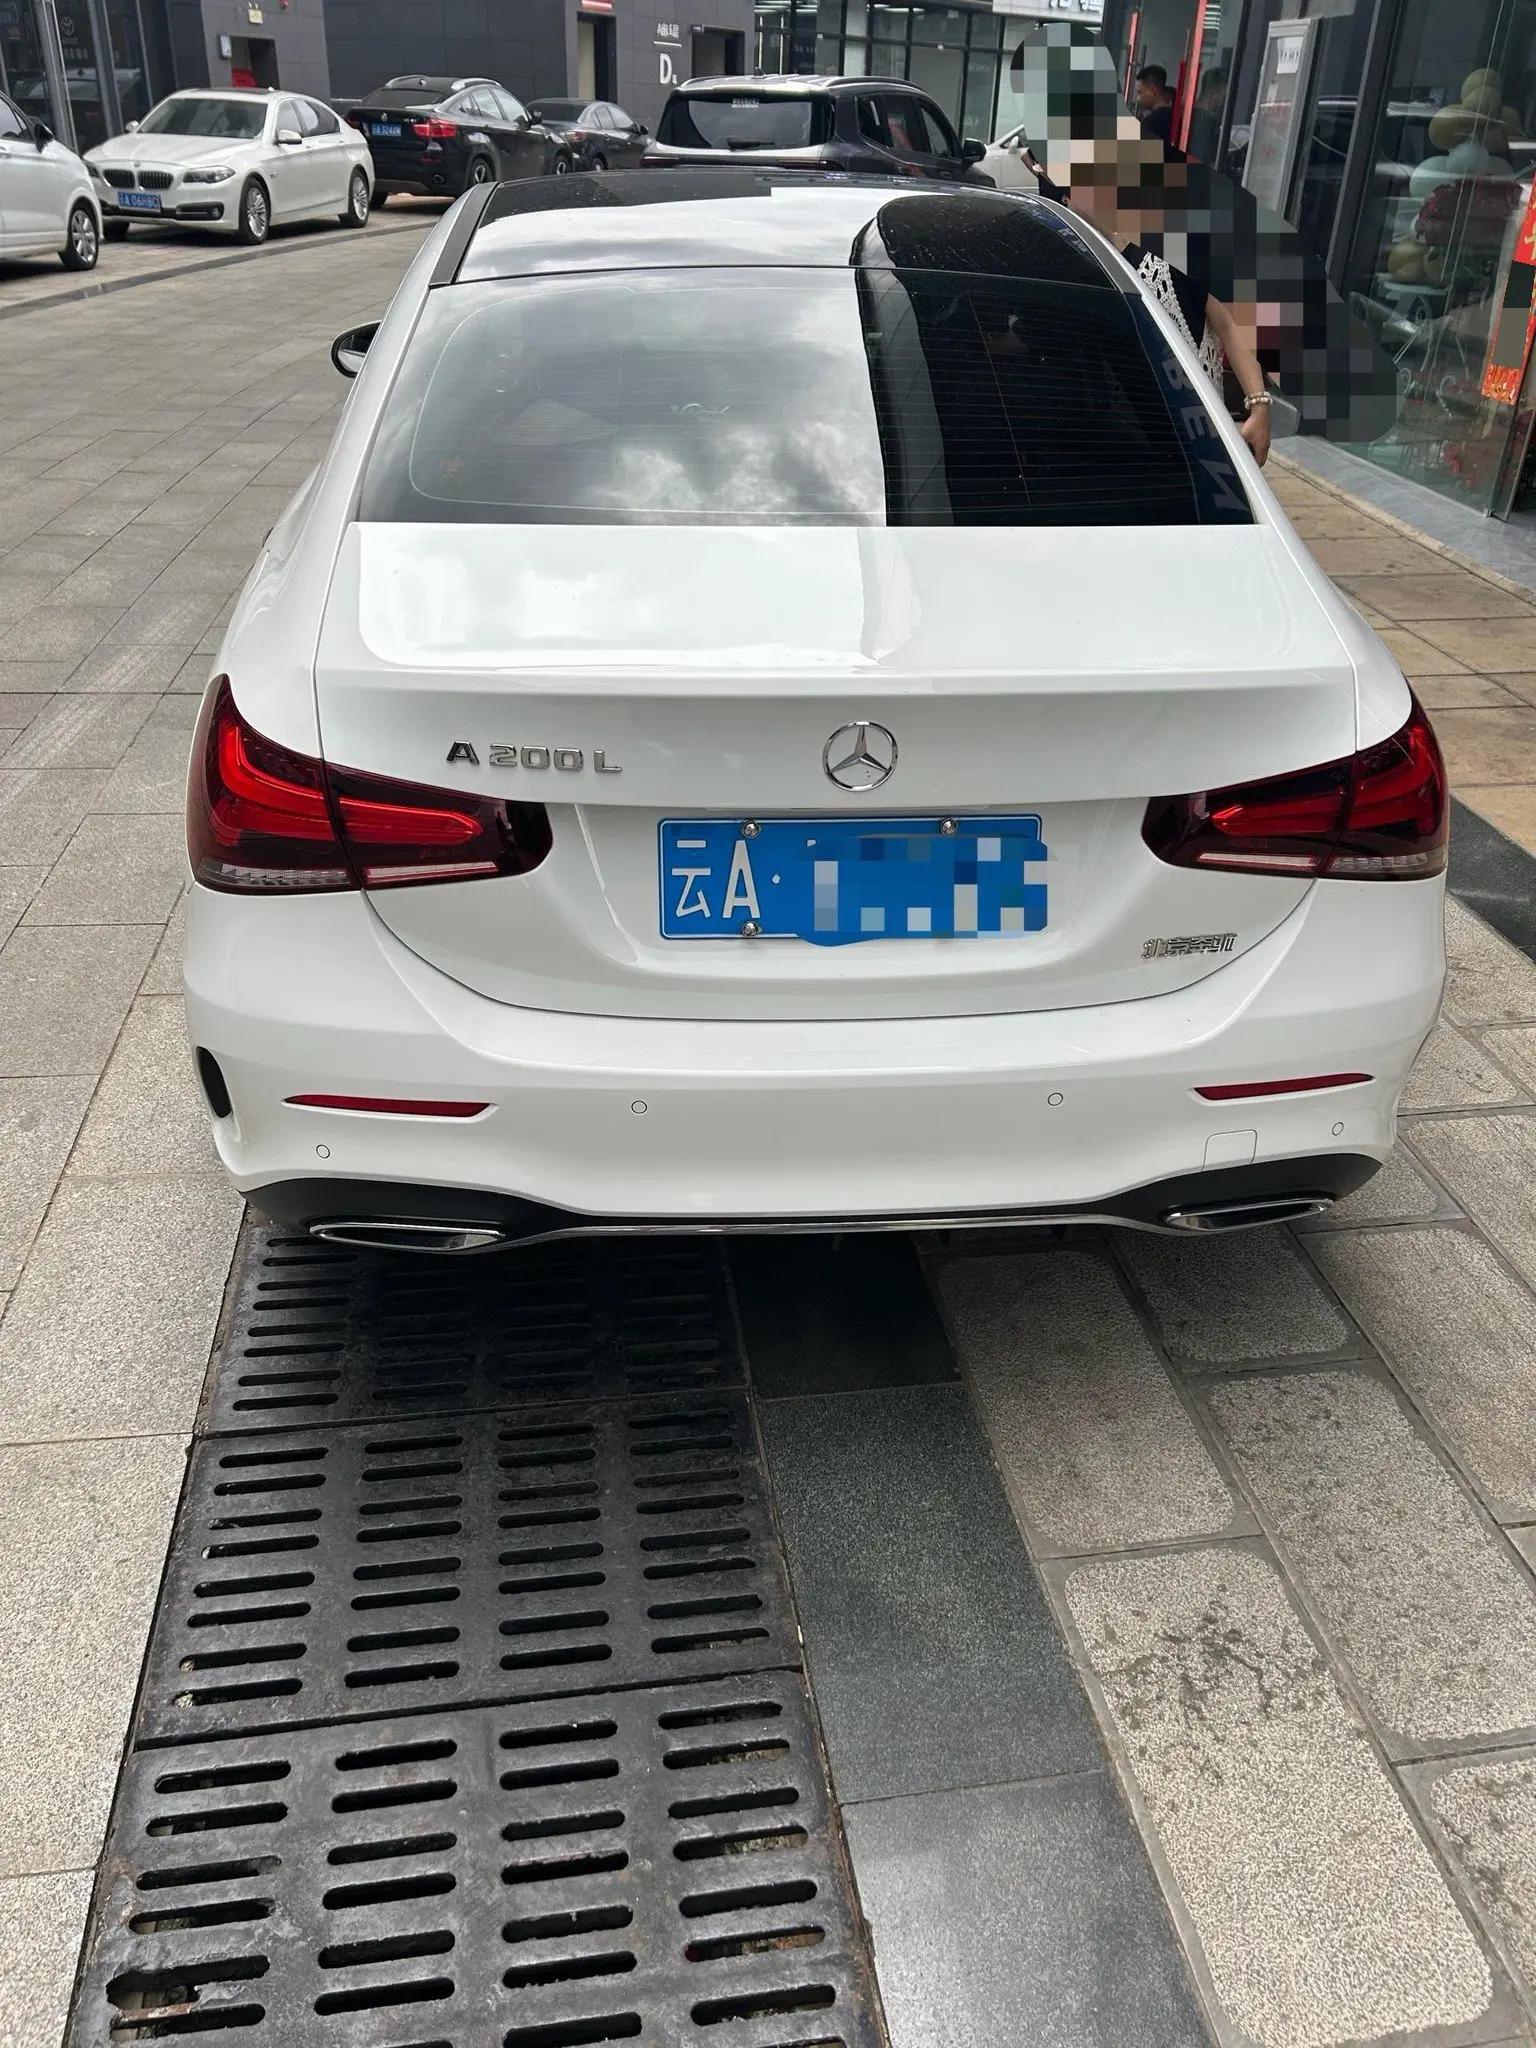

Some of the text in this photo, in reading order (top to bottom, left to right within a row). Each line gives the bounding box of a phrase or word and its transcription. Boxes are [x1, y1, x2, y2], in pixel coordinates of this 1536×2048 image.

[446, 740, 623, 772] A 200 L
